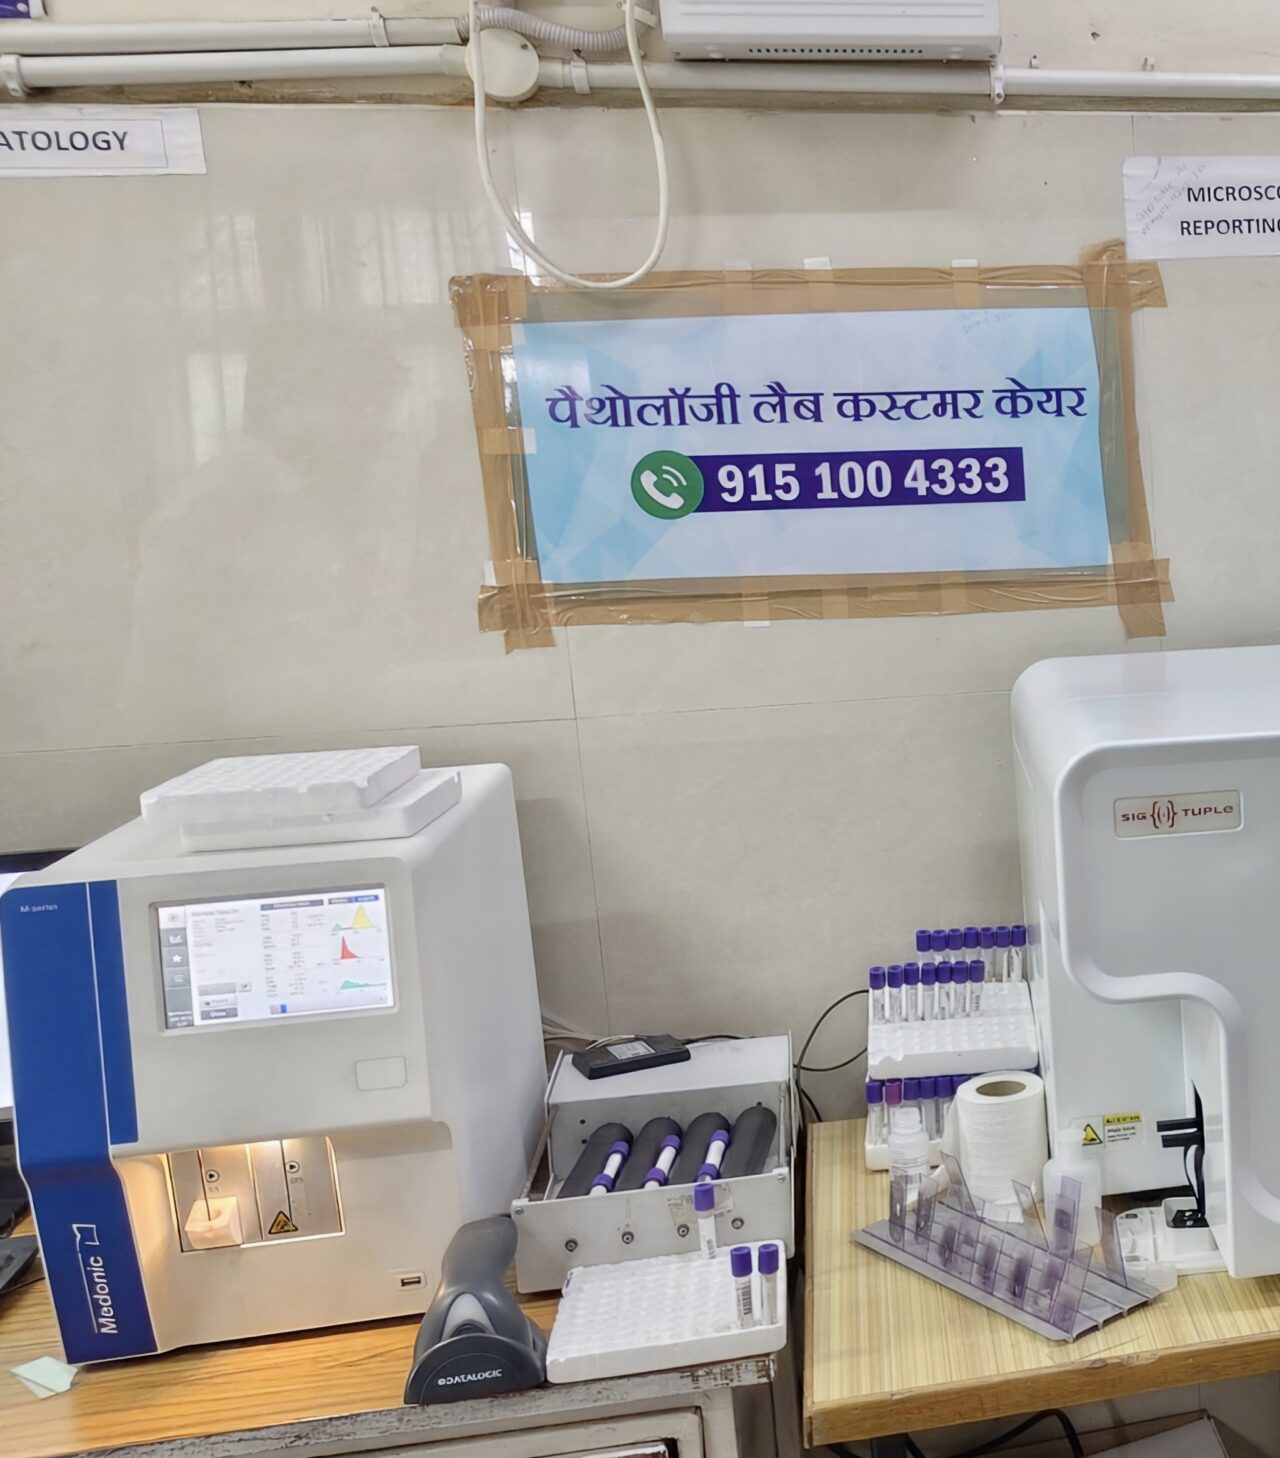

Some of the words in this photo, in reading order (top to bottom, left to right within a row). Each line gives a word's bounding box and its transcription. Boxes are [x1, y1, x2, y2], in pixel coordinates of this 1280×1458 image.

[545, 382, 742, 429] पैथोलॉजी
[750, 381, 824, 424] लैब
[833, 389, 984, 423] कस्टमर
[992, 377, 1088, 419] केयर
[719, 463, 800, 503] 915
[814, 459, 892, 501] 100
[903, 455, 1010, 496] 4333
[86, 1255, 118, 1334] Medonic
